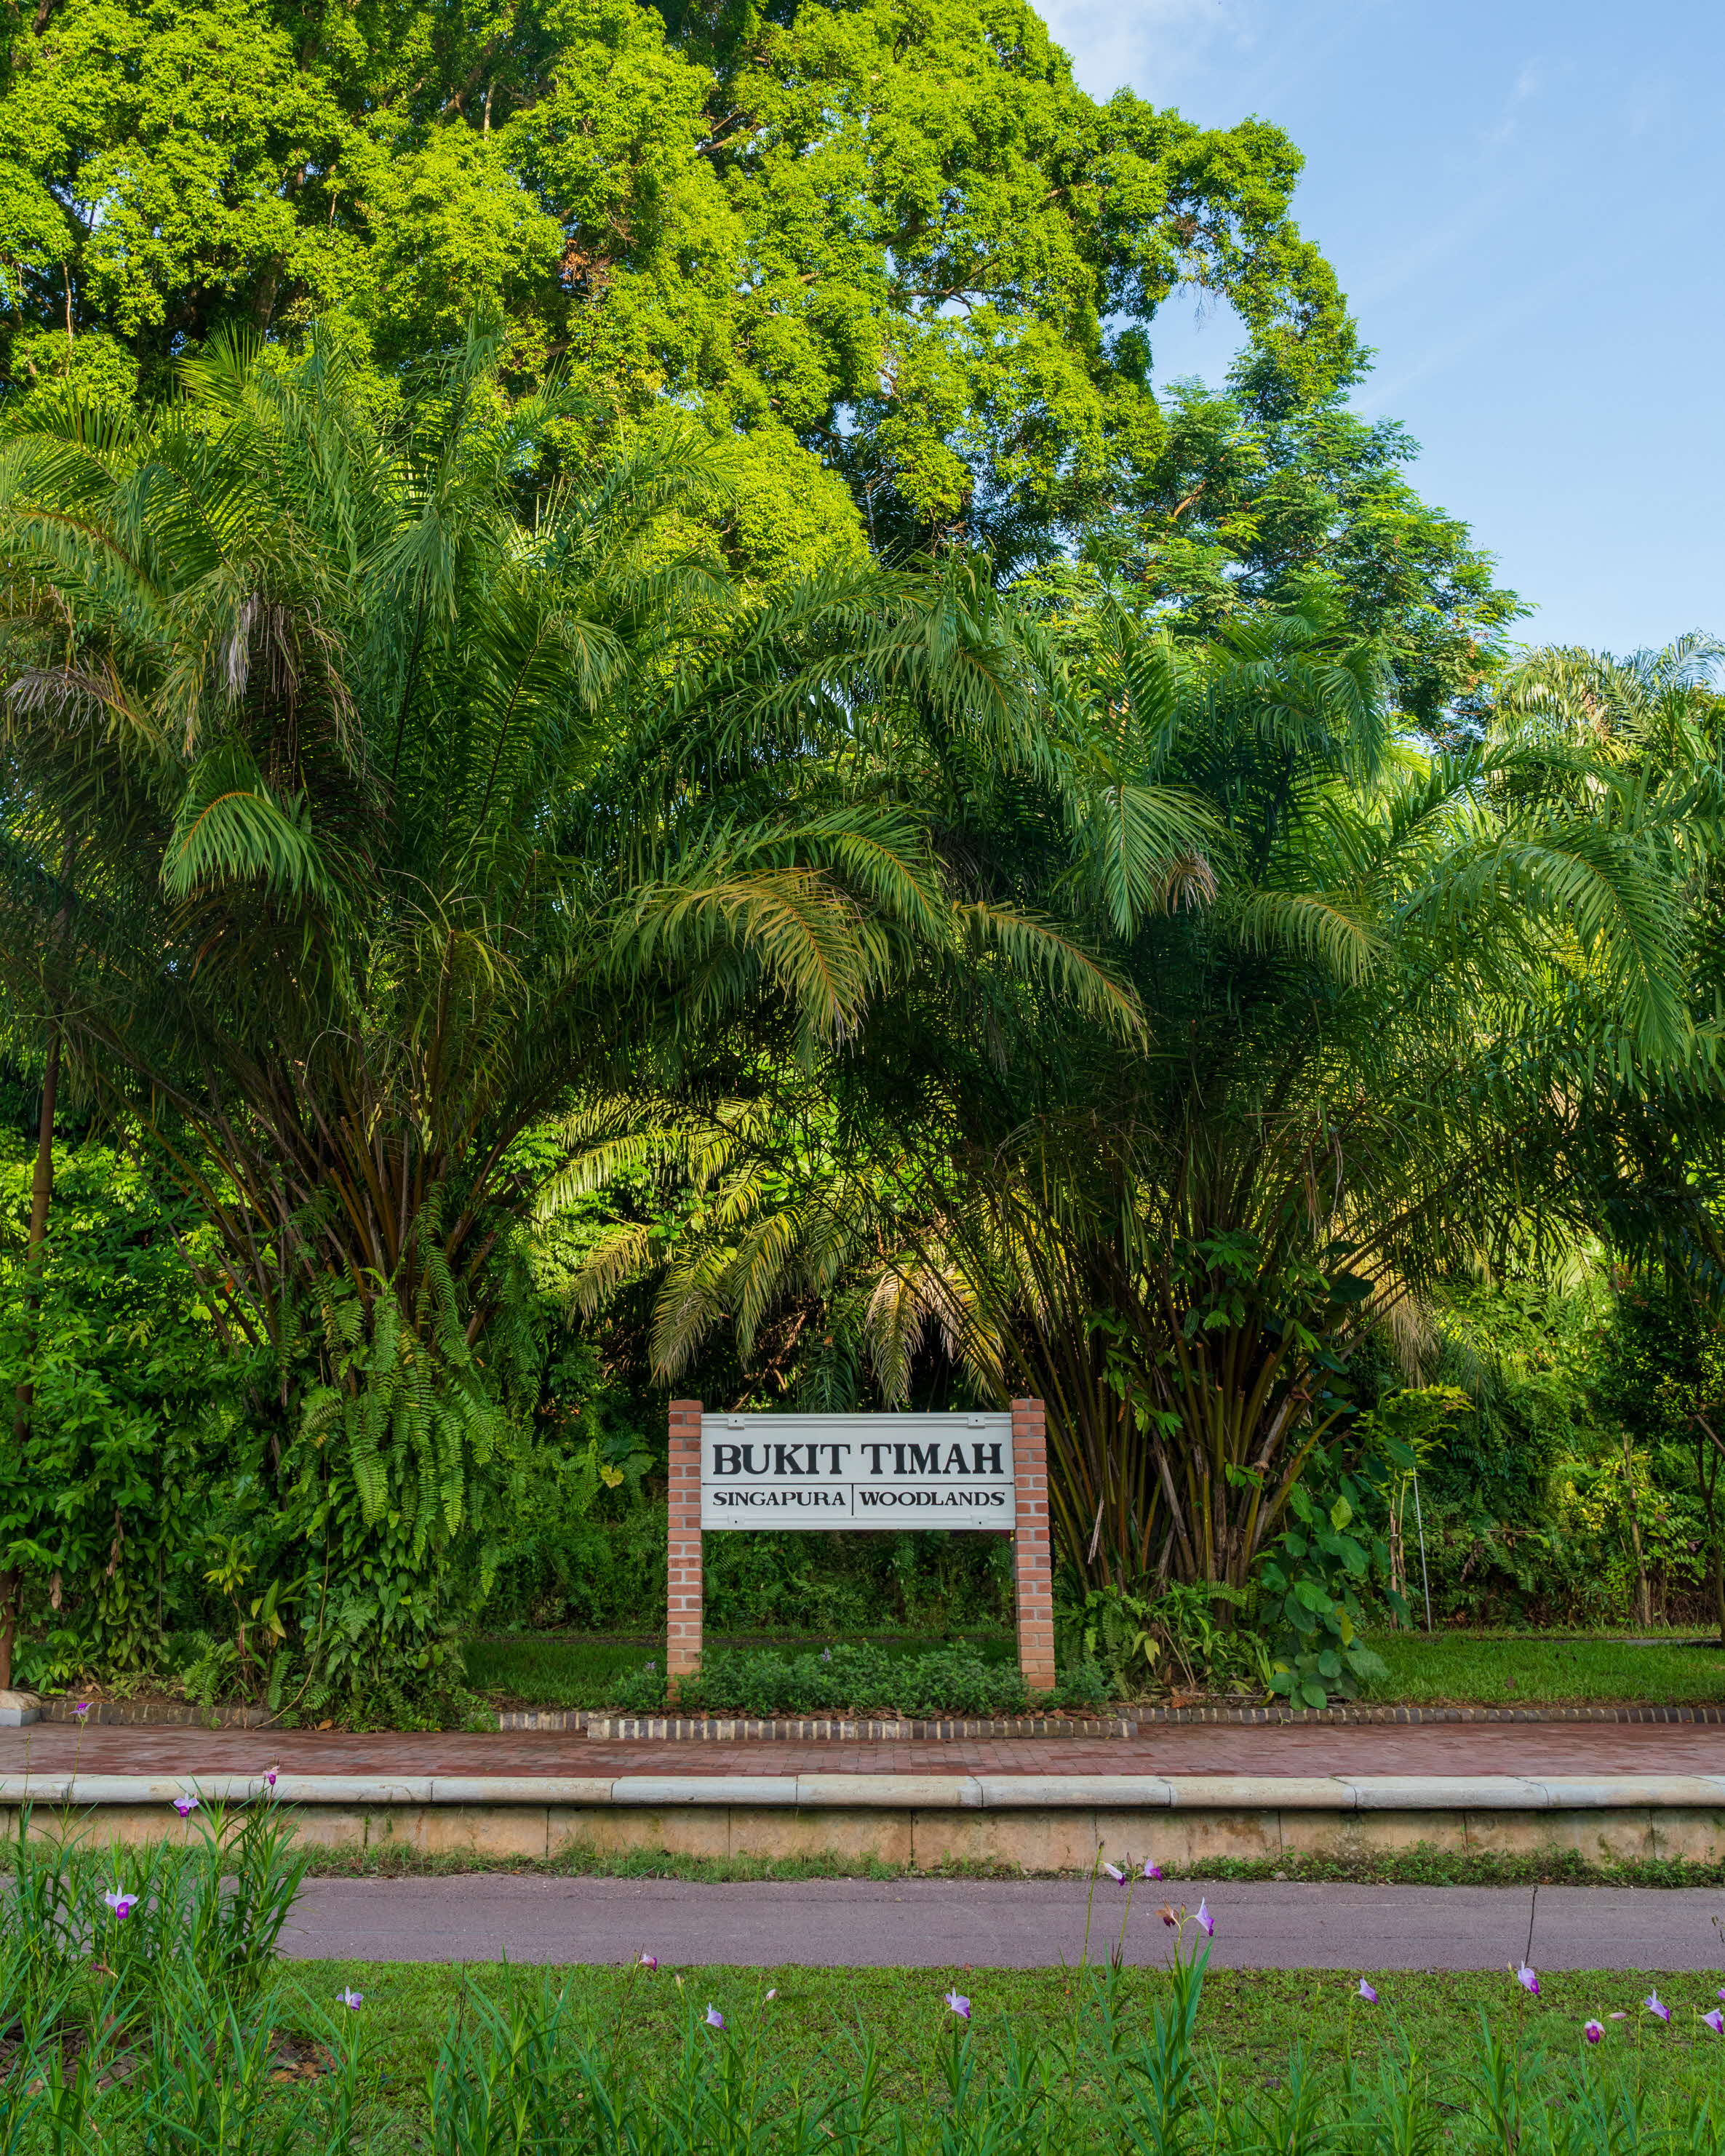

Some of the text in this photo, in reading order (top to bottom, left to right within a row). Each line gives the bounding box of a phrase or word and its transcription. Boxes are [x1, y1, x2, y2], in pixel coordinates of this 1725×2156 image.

[713, 1443, 1004, 1474] BUKIT TIMAH
[713, 1492, 845, 1506] SINGAPURA
[859, 1492, 1005, 1506] WOODLANDS
